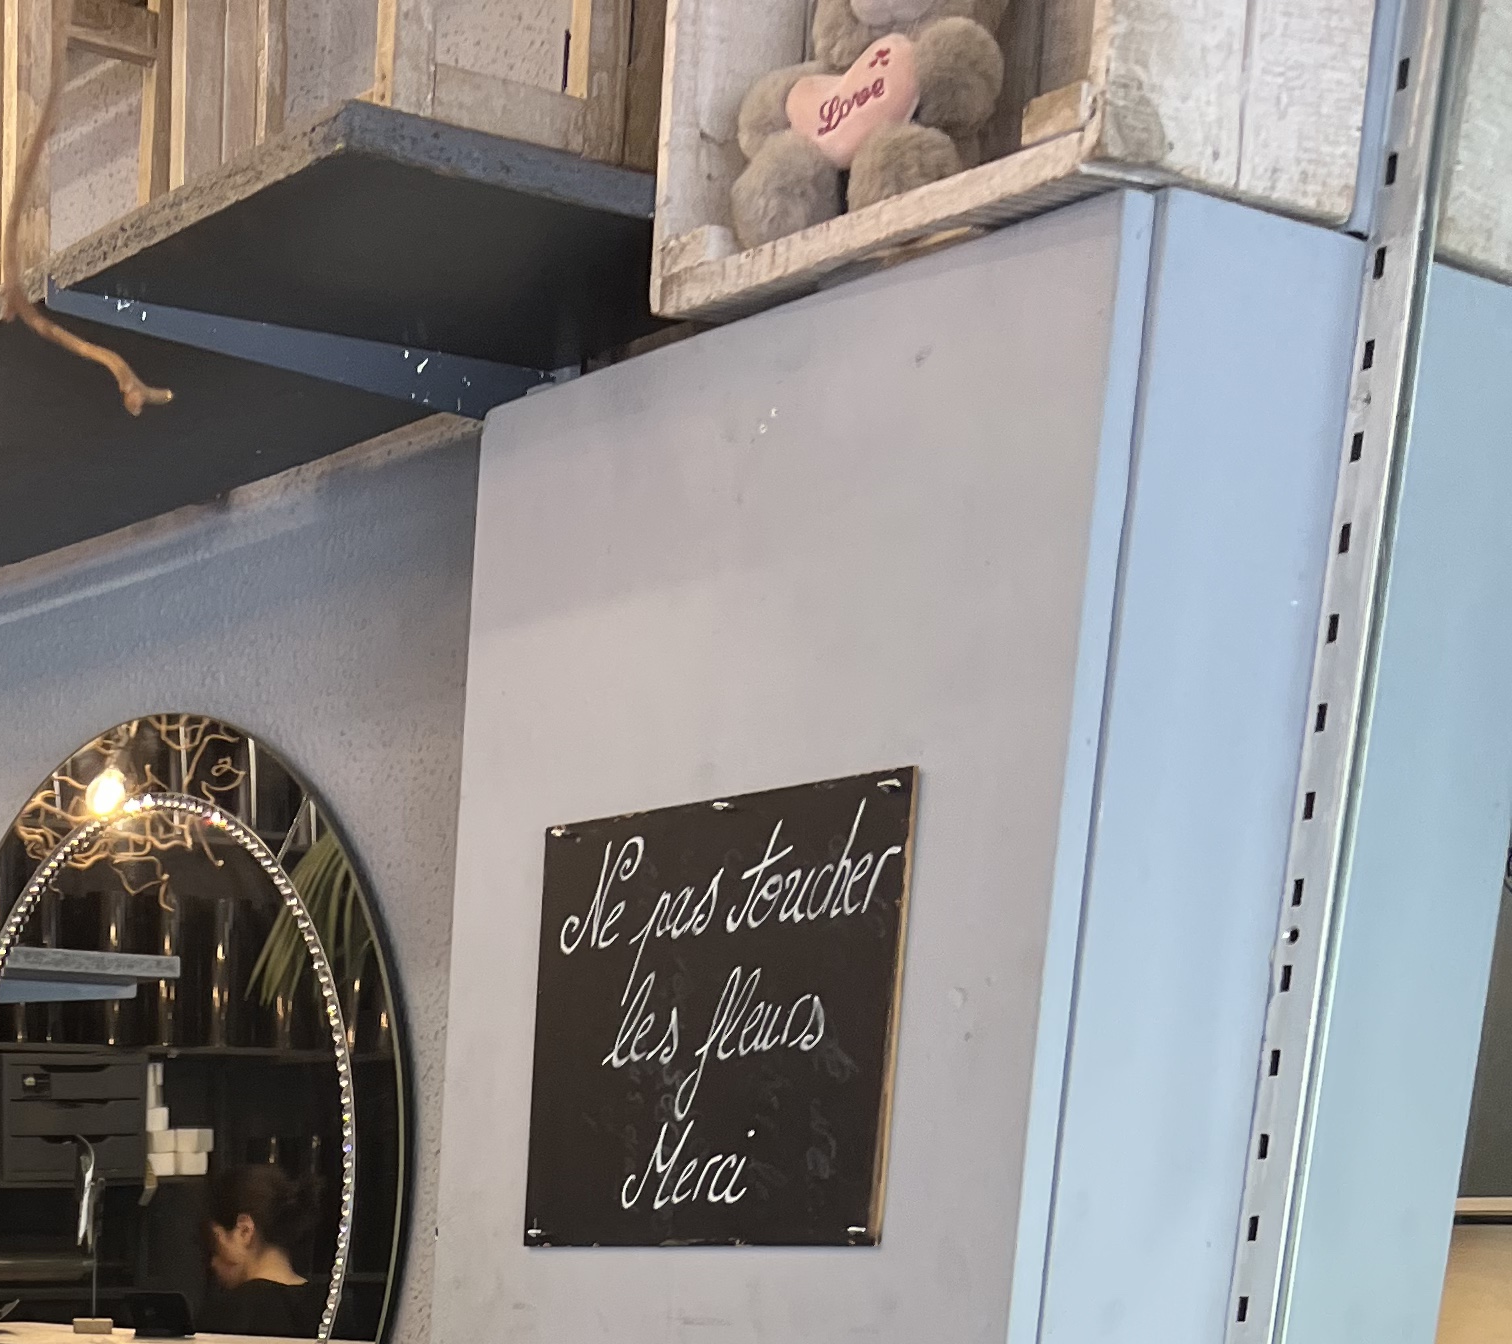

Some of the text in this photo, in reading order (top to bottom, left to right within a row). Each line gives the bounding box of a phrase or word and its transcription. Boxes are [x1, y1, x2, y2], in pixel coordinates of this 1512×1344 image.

[817, 77, 885, 136] Love
[560, 797, 902, 1006] Ne pas toucher
[602, 965, 826, 1121] les fleurs
[621, 1119, 756, 1210] Merci
